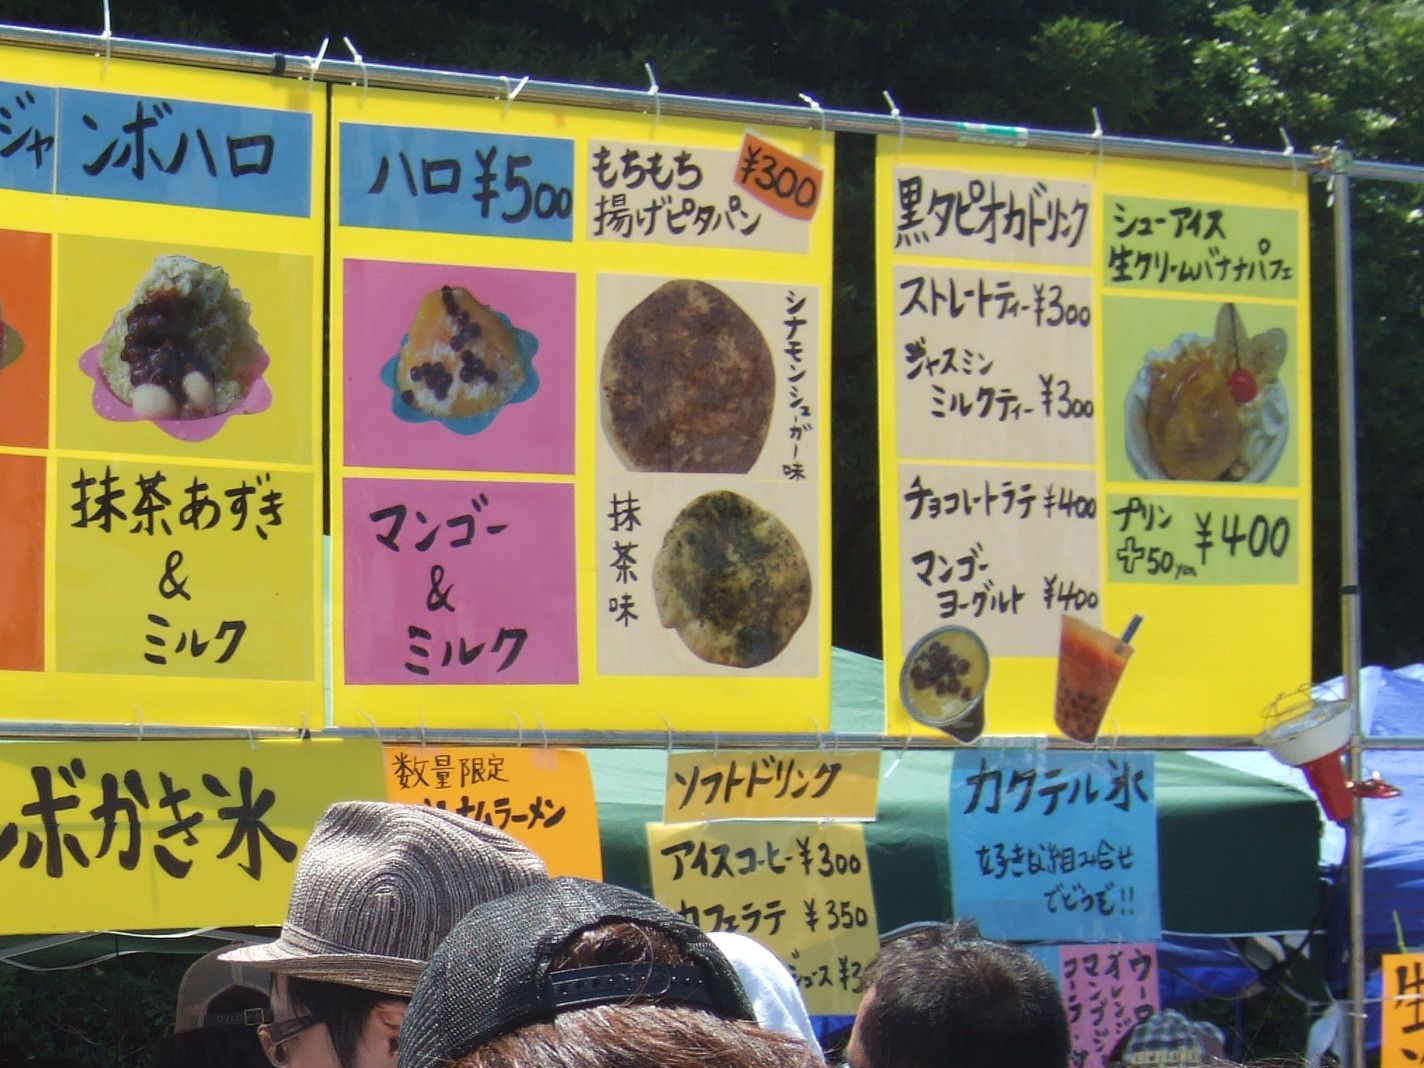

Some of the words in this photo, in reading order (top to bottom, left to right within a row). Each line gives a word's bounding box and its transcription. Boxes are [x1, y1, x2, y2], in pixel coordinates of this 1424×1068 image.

[591, 145, 705, 191] もちもち
[739, 144, 818, 208] ¥300
[592, 193, 762, 239] 揚げピタパン
[895, 175, 1090, 249] 黒タピオカドリンク
[1113, 202, 1226, 241] シューアイス
[1108, 237, 1294, 284] 生クリームバナナパフェ
[904, 336, 995, 381] ジャスミン
[70, 464, 284, 541] 抹茶あずき
[368, 492, 510, 553] マンゴー
[1112, 496, 1174, 532] プリン
[607, 490, 643, 628] 抹茶味
[1194, 511, 1291, 566] ¥400
[158, 550, 193, 601] &
[426, 564, 457, 613] &
[910, 542, 990, 587] マンゴー
[936, 580, 1026, 619] ヨーグルト
[143, 613, 248, 666] ミルク
[404, 624, 529, 677] ミルク
[392, 751, 510, 790] 数量限定
[674, 755, 843, 810] ソフトドリンク
[423, 795, 567, 831] ナムラーメン
[802, 897, 869, 933] ¥350
